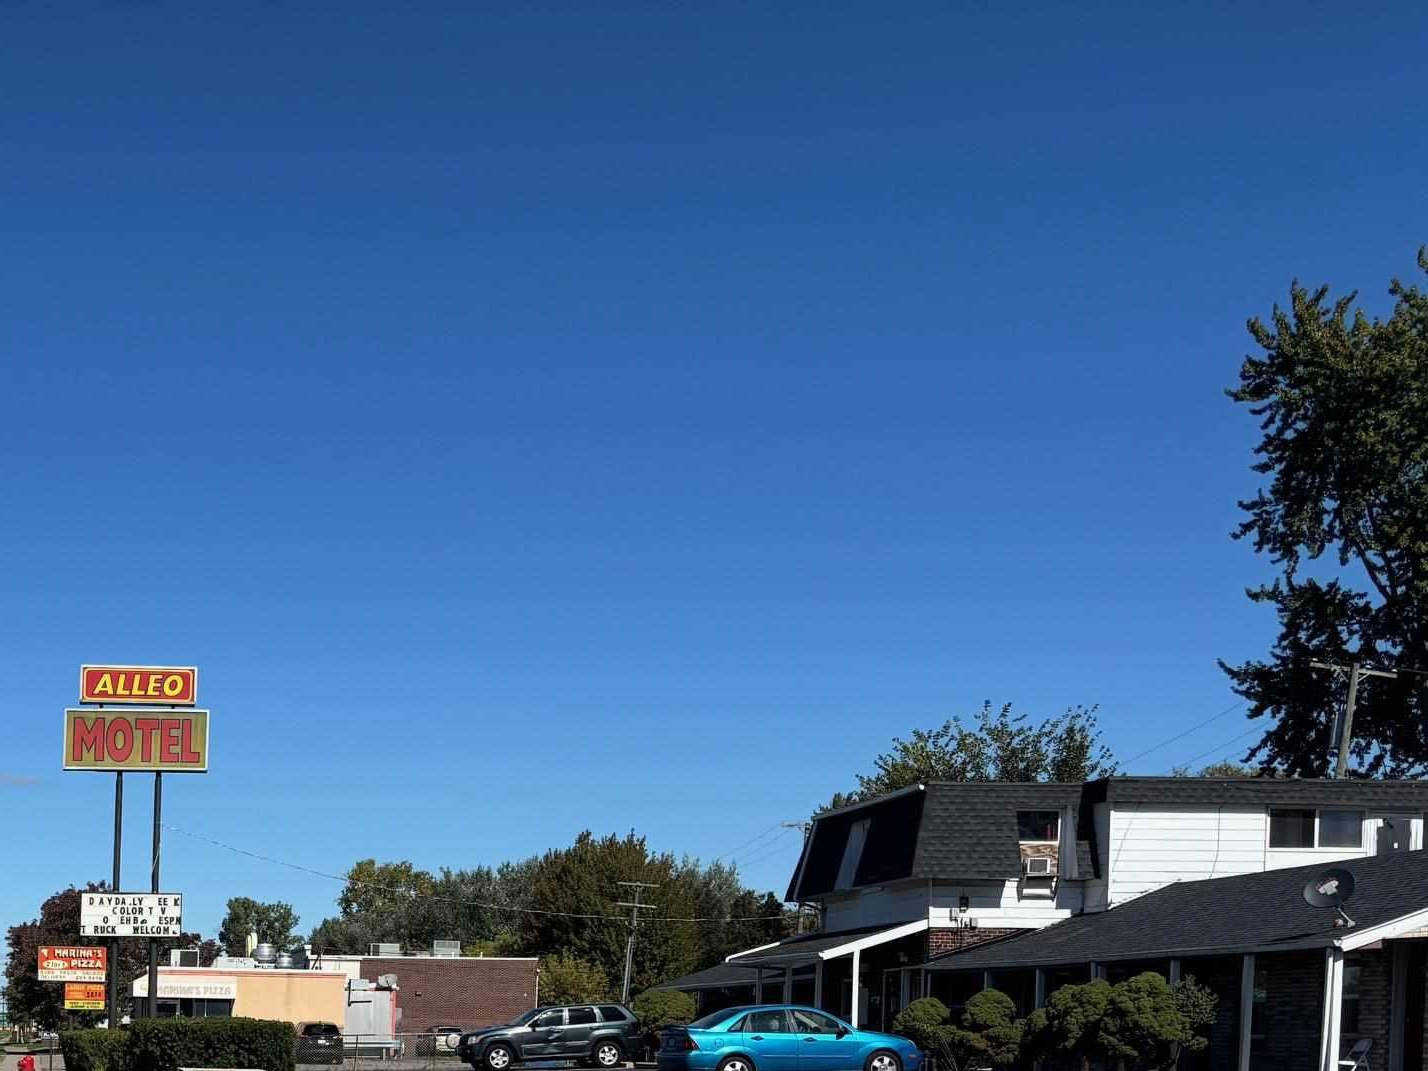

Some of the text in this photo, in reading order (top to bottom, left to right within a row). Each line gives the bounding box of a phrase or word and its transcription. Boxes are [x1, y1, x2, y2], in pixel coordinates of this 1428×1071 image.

[93, 673, 184, 697] ALLEO
[73, 716, 200, 764] MOTEL
[112, 906, 144, 915] COLOR
[54, 948, 103, 959] MARINA'S
[70, 959, 103, 969] PIZZA
[203, 984, 232, 996] PIZZA
